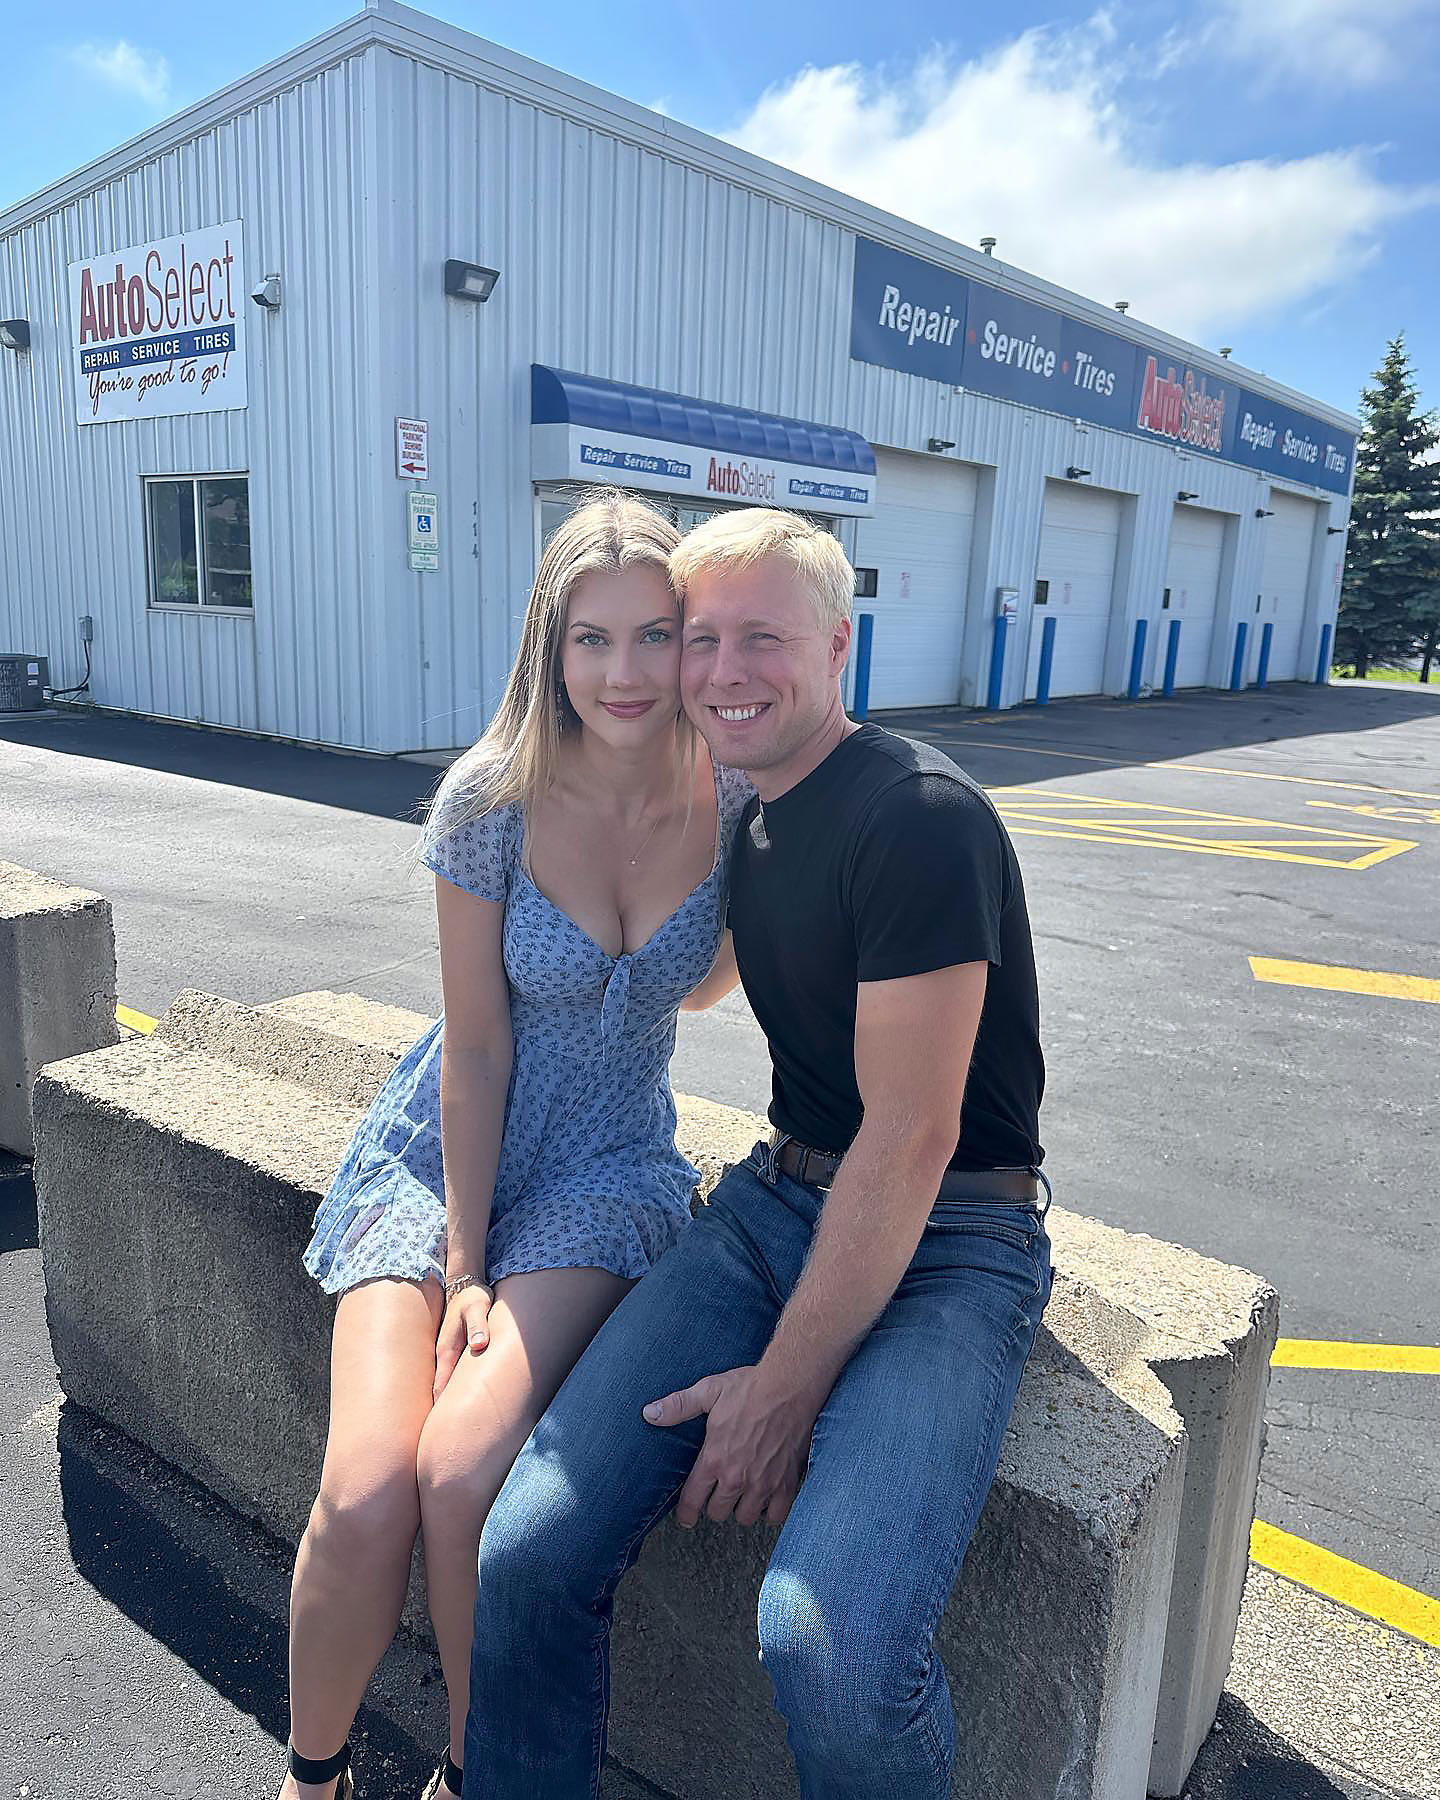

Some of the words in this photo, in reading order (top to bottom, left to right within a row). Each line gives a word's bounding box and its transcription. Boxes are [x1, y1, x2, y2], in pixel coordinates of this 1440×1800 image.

[80, 240, 235, 344] AutoSelect
[84, 350, 120, 368] REPAIR
[131, 340, 180, 360] SERVICE
[194, 332, 230, 350] TIRES
[879, 285, 960, 346] Repair
[981, 321, 1056, 378] Service
[1074, 352, 1116, 396] Tires
[87, 371, 133, 416] You're
[138, 359, 175, 402] good
[180, 359, 198, 383] to
[202, 352, 228, 395] go!
[584, 447, 616, 464] Repair
[624, 454, 658, 471] Service
[666, 461, 689, 475] Tires
[1240, 412, 1277, 450] Repair
[1283, 429, 1319, 464] Service
[1324, 444, 1347, 474] Tires
[707, 456, 776, 500] AutoSelect
[791, 480, 814, 494] Repair
[819, 485, 845, 497] Service
[850, 489, 867, 500] Tires
